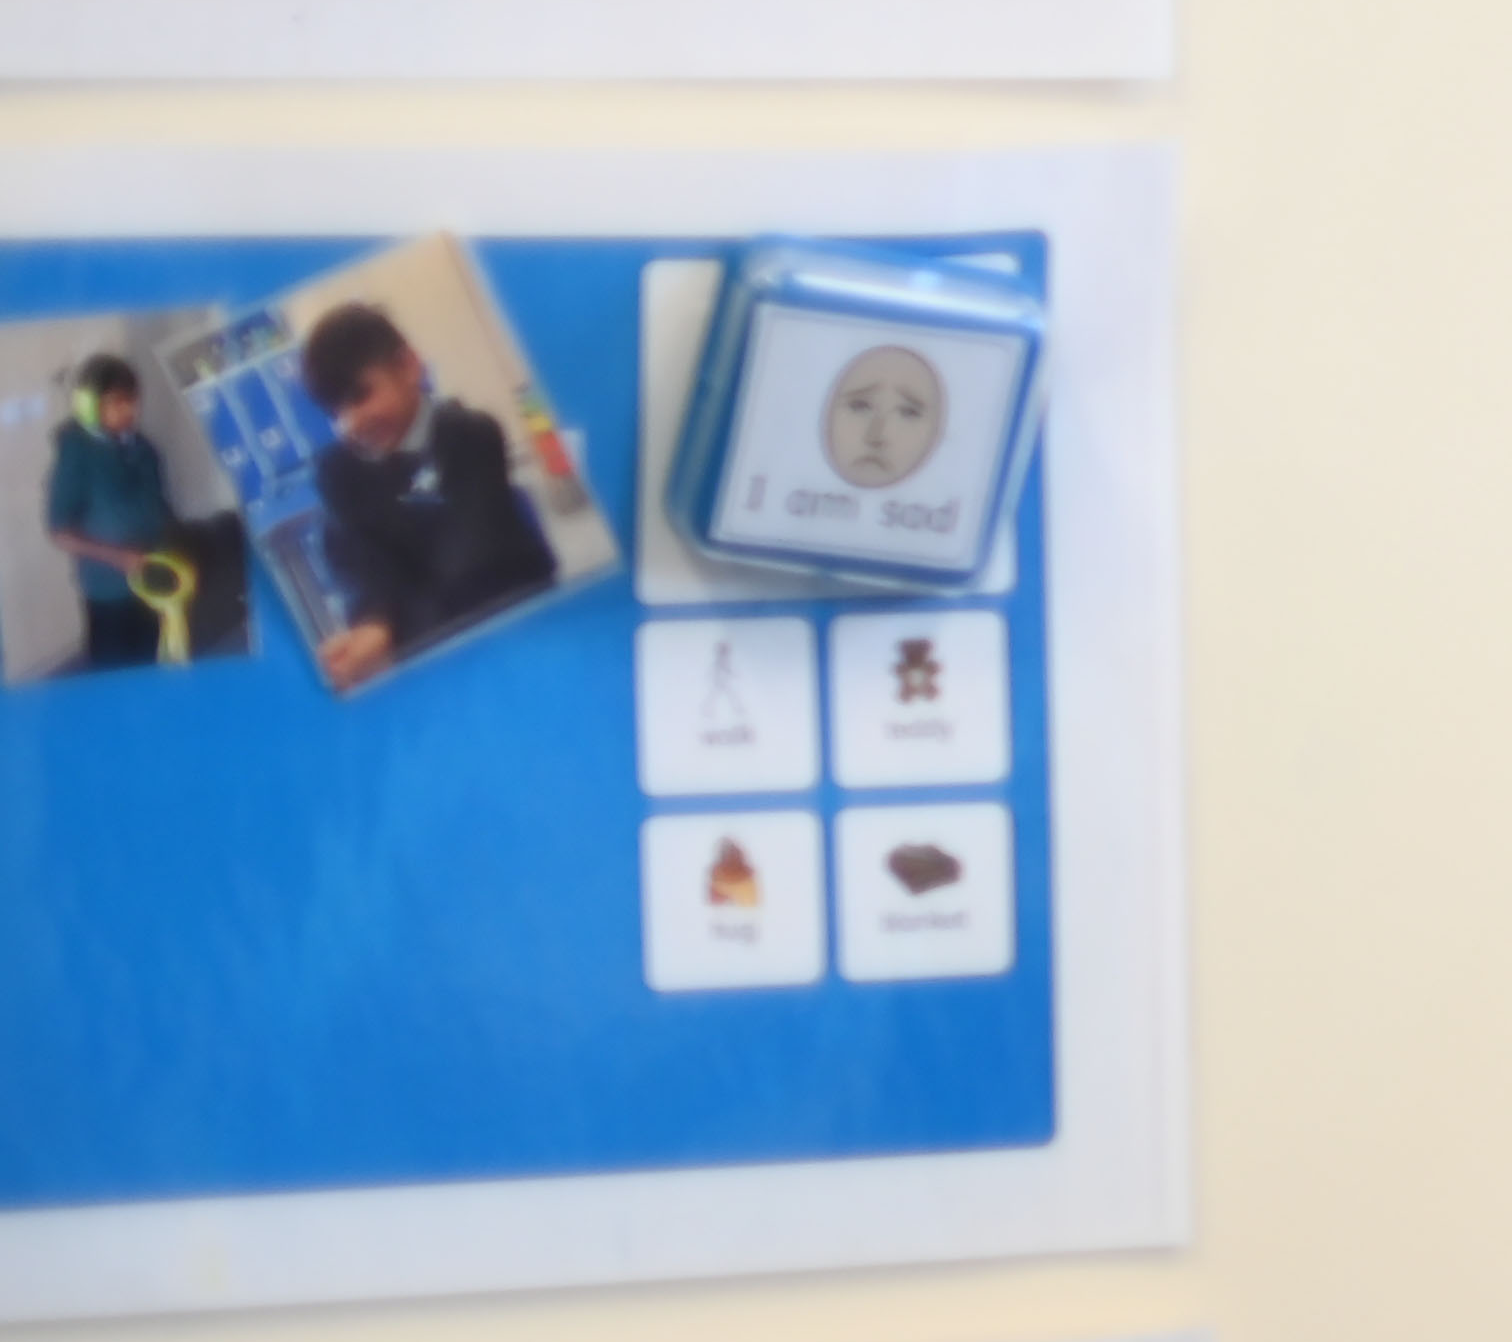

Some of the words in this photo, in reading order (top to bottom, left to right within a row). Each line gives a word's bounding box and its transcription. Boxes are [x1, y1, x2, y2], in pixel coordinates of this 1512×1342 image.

[744, 474, 767, 512] I
[785, 488, 860, 518] am
[880, 496, 962, 534] sad
